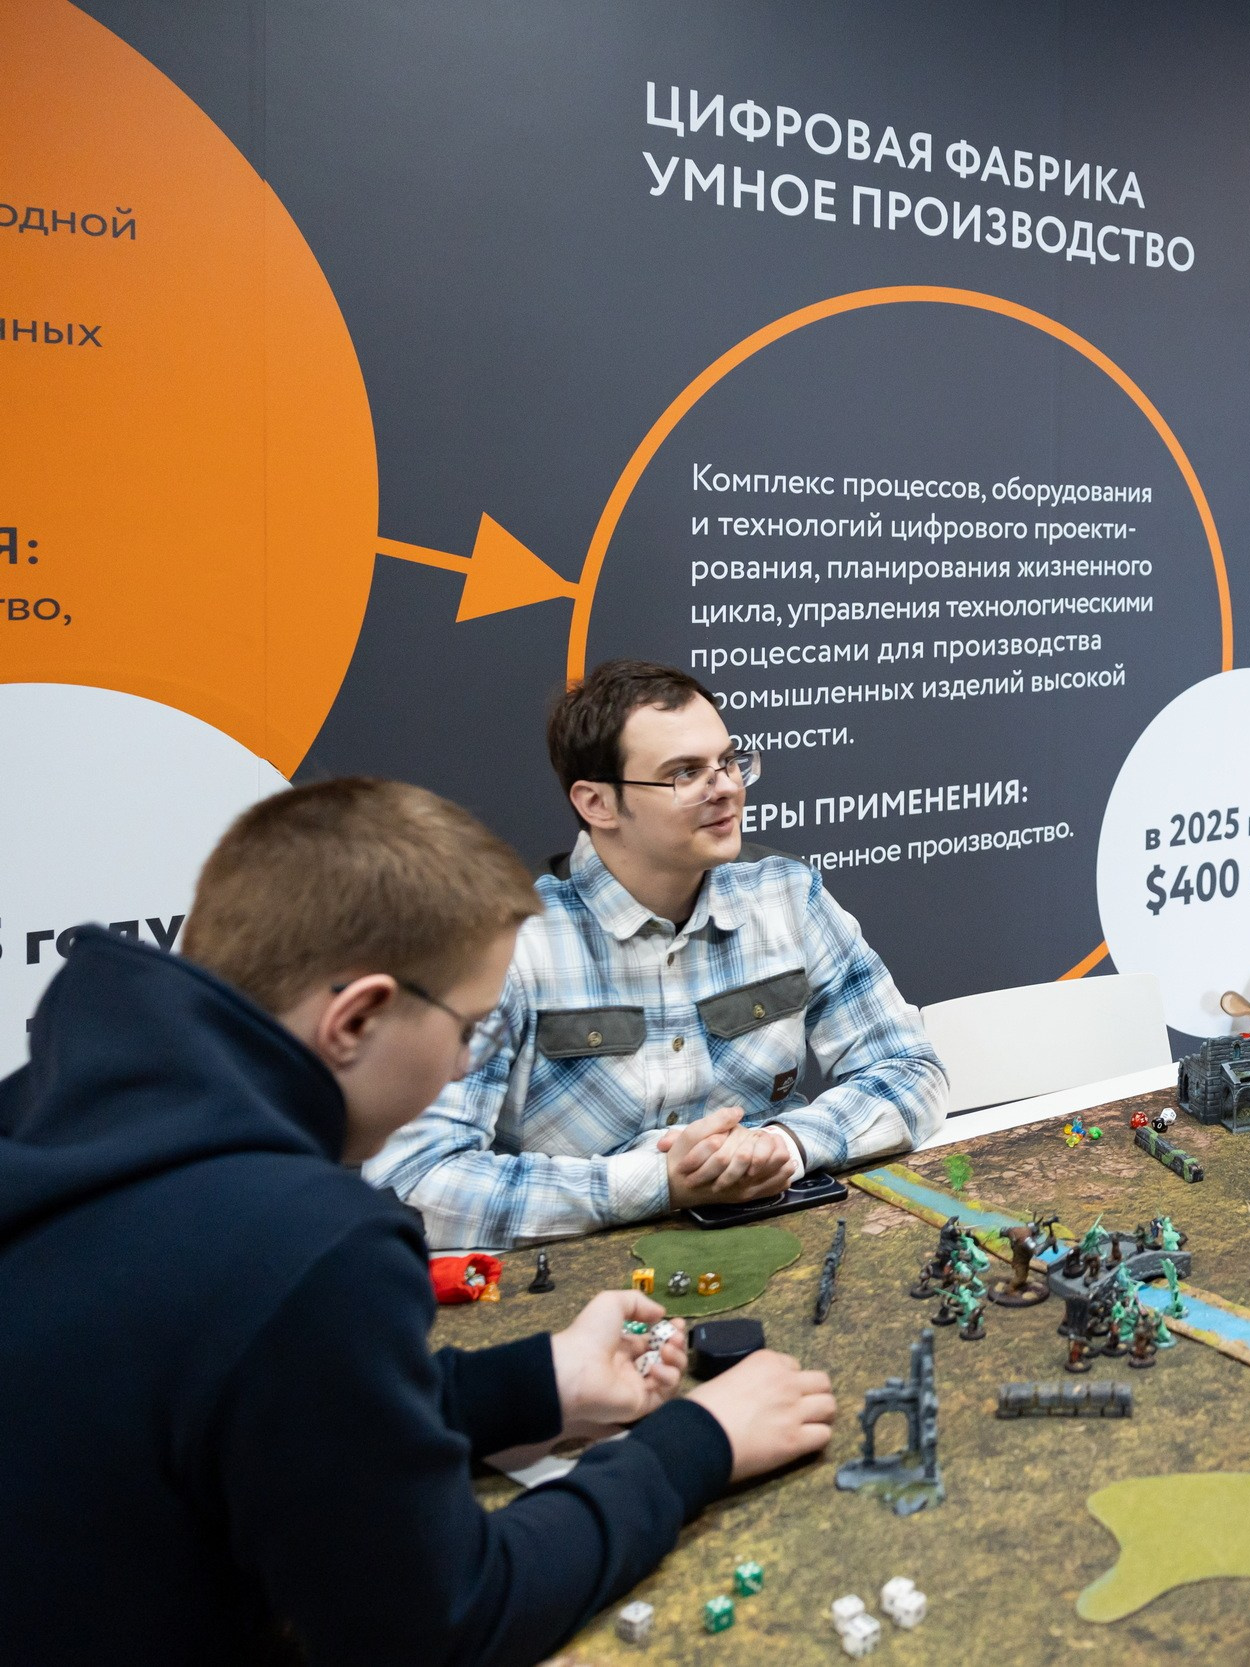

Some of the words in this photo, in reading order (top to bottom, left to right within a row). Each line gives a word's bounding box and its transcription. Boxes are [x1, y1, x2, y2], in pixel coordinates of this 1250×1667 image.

[645, 81, 932, 172] ЦИФРОВАЯ
[945, 139, 1146, 209] ФАБРИКА
[642, 152, 837, 222] УМНОЕ
[852, 185, 1195, 272] ПРОИЗВОДСТВО
[0, 317, 103, 348] ных
[692, 463, 835, 495] Комплекс
[843, 476, 987, 503] процессов,
[991, 476, 1152, 508] оборудования
[691, 516, 709, 536] и
[718, 512, 882, 538] технологий
[891, 513, 1028, 544] цифрового
[1034, 521, 1136, 546] проекти-
[691, 561, 820, 587] рования,
[827, 561, 1011, 585] планирования
[1017, 559, 1153, 578] жизненного
[691, 603, 783, 627] цикла,
[787, 602, 940, 628] управления
[945, 596, 1153, 618] технологическими
[691, 644, 869, 675] процессами
[877, 641, 924, 664] для
[933, 633, 1102, 663] производства
[713, 683, 914, 710] ромышленных
[923, 670, 1024, 701] изделий
[1031, 663, 1126, 693] высокой
[729, 727, 855, 750] ожности.
[742, 800, 805, 833] ЕРЫ
[815, 779, 1028, 825] ПРИМЕНЕНИЯ:
[804, 845, 902, 871] ленное
[908, 821, 1074, 865] производство.
[1145, 828, 1161, 851] в
[1169, 807, 1240, 847] 2025
[1146, 858, 1240, 916] $400
